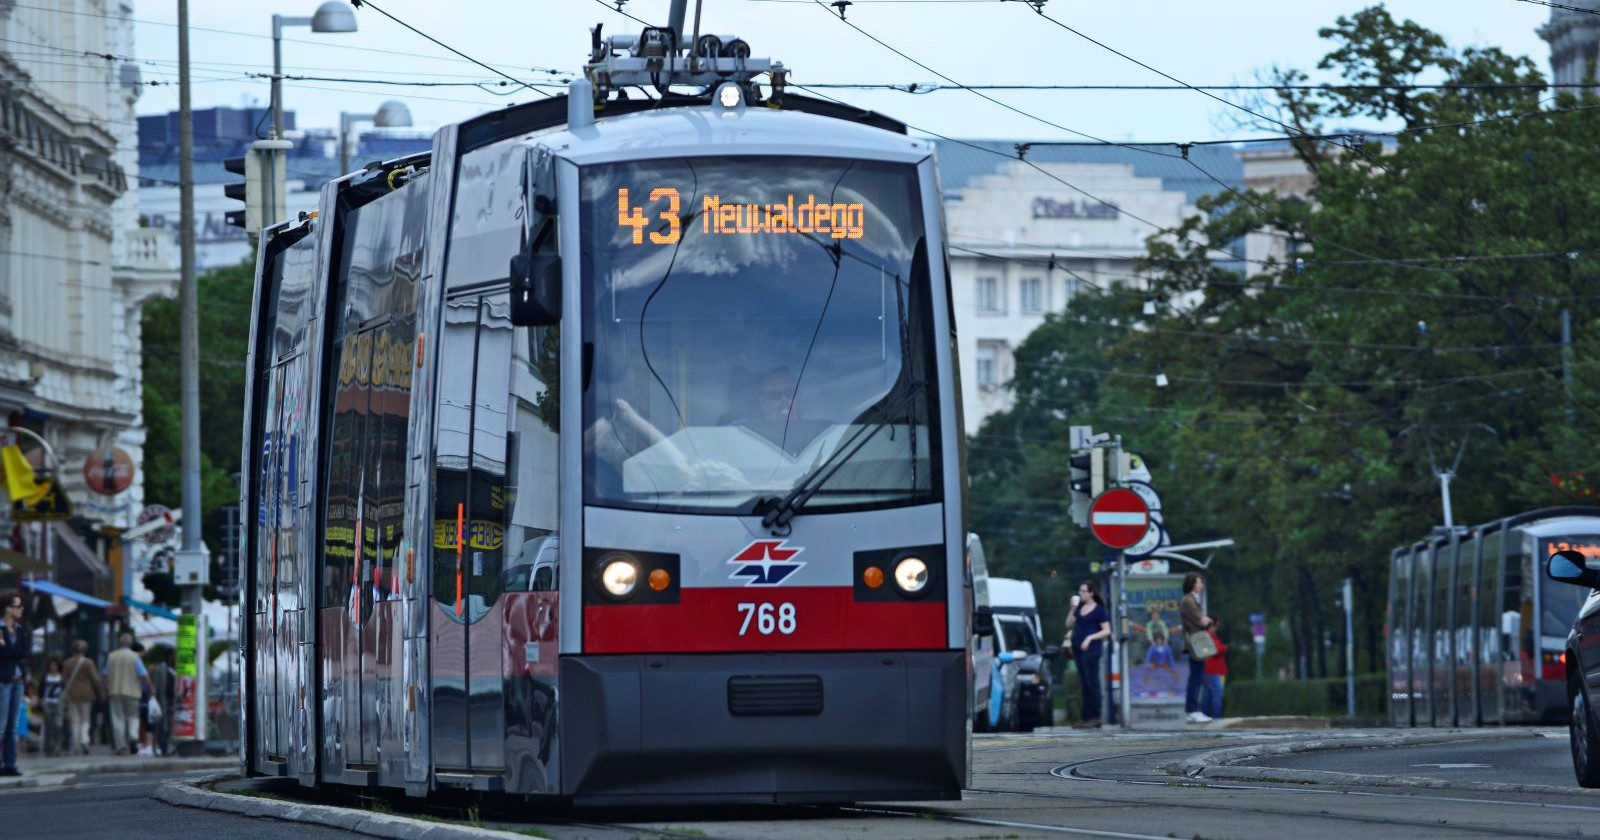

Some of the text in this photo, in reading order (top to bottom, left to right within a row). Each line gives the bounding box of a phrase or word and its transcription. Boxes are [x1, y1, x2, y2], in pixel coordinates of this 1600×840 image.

[617, 186, 864, 245] 43 Neuwaldegg
[736, 601, 797, 636] 768
